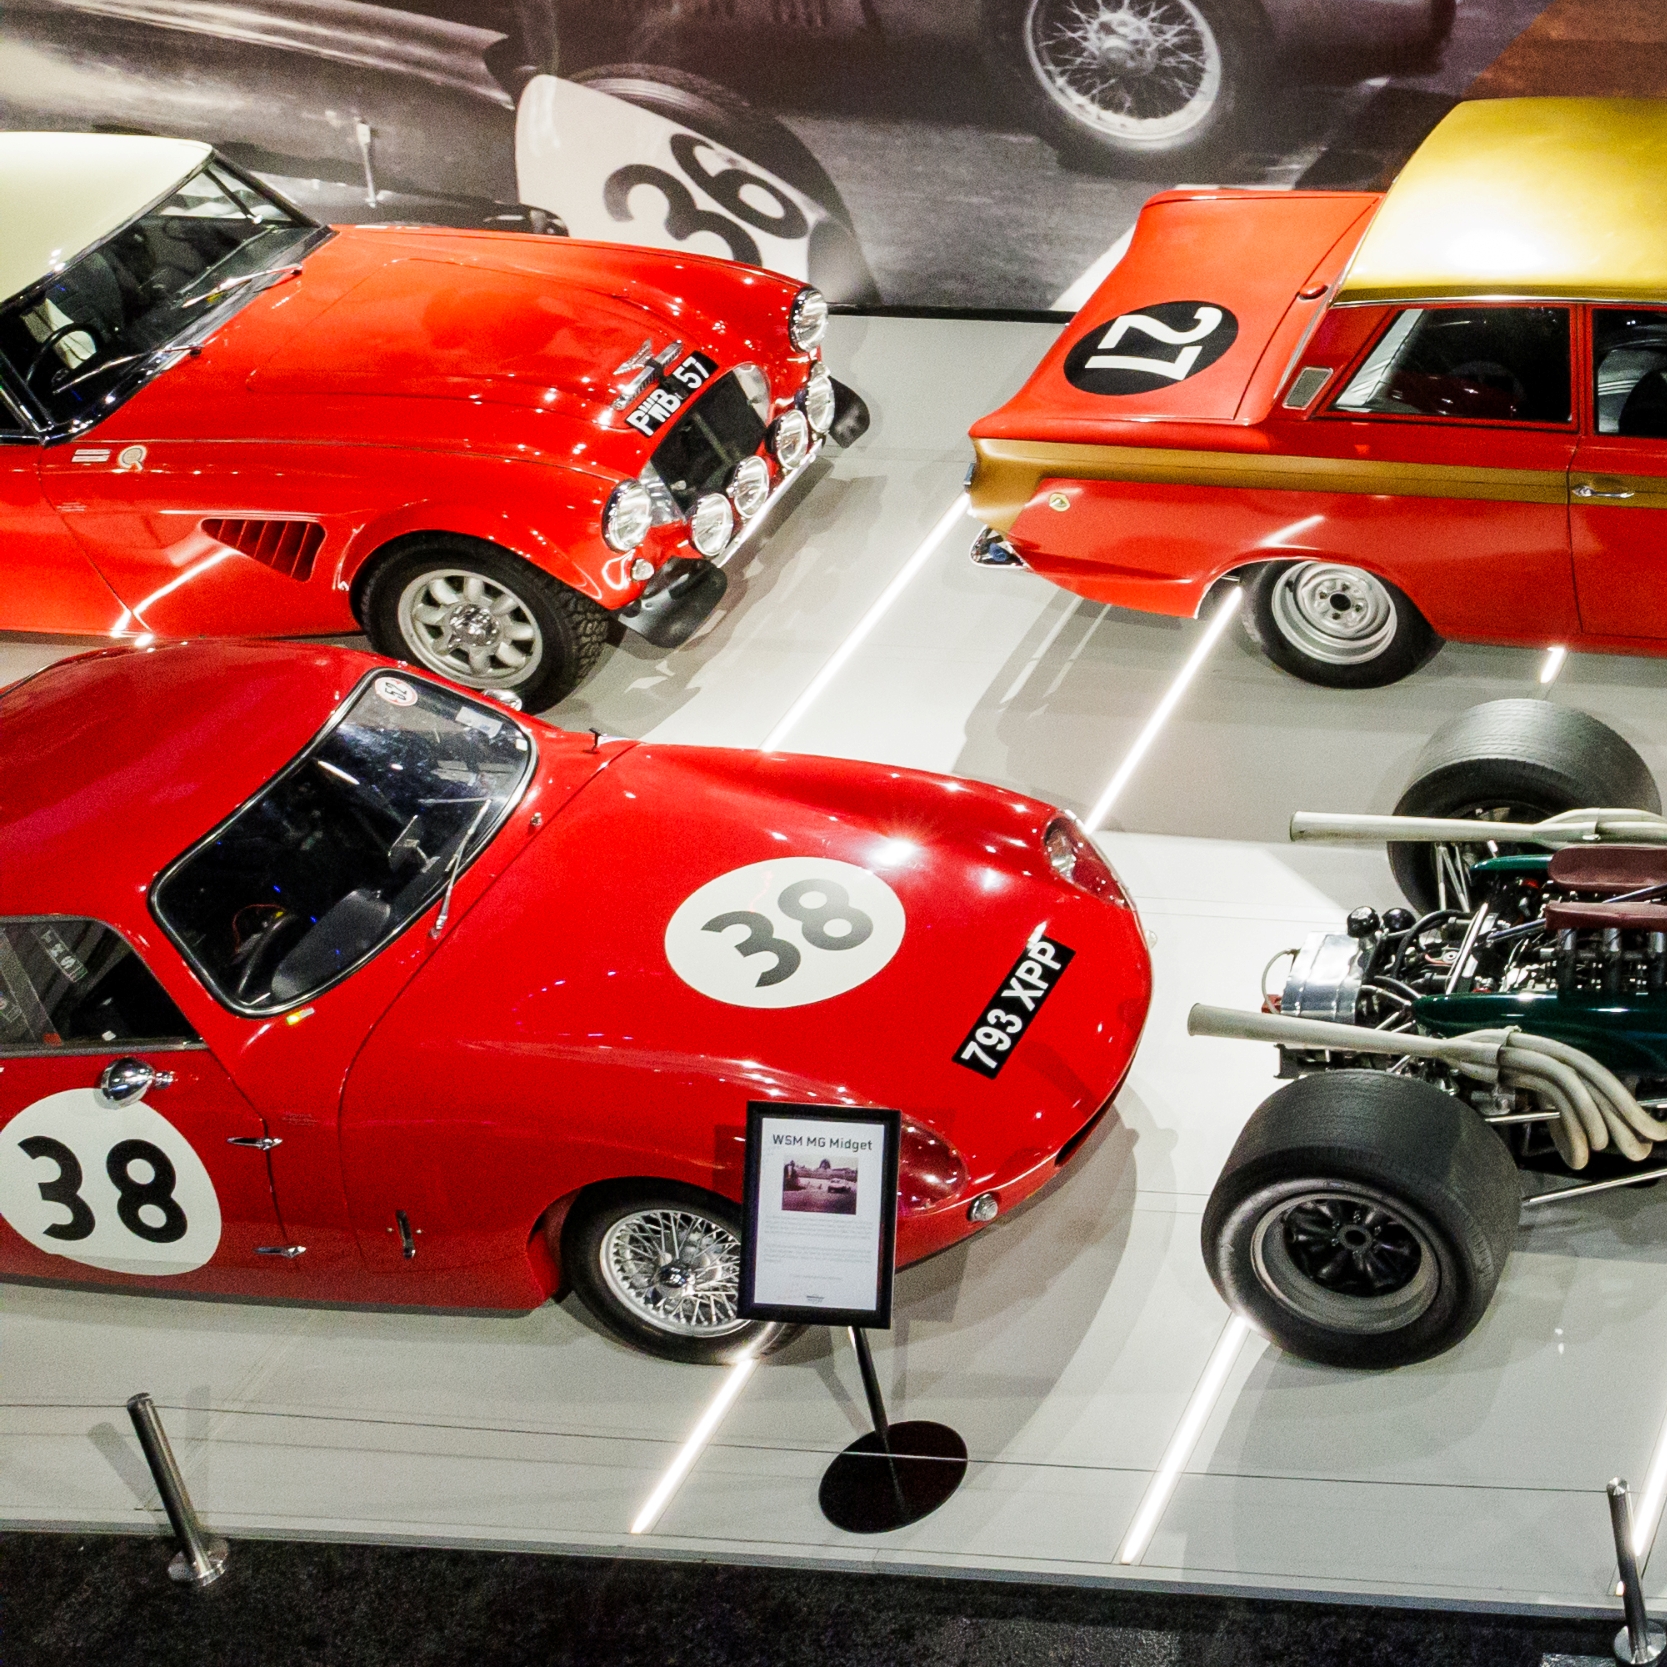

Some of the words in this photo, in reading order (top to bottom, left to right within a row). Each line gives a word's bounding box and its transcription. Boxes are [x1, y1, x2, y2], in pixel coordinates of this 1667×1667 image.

[603, 132, 809, 266] 36
[627, 384, 684, 438] PWB
[674, 354, 712, 394] 57
[1085, 306, 1223, 382] 27
[701, 877, 875, 989] 38
[960, 1008, 1025, 1071] 793
[1000, 938, 1066, 1022] XPP
[17, 1134, 190, 1245] 38
[772, 1133, 804, 1147] WSM
[806, 1136, 827, 1149] MG
[829, 1138, 874, 1153] Midget
